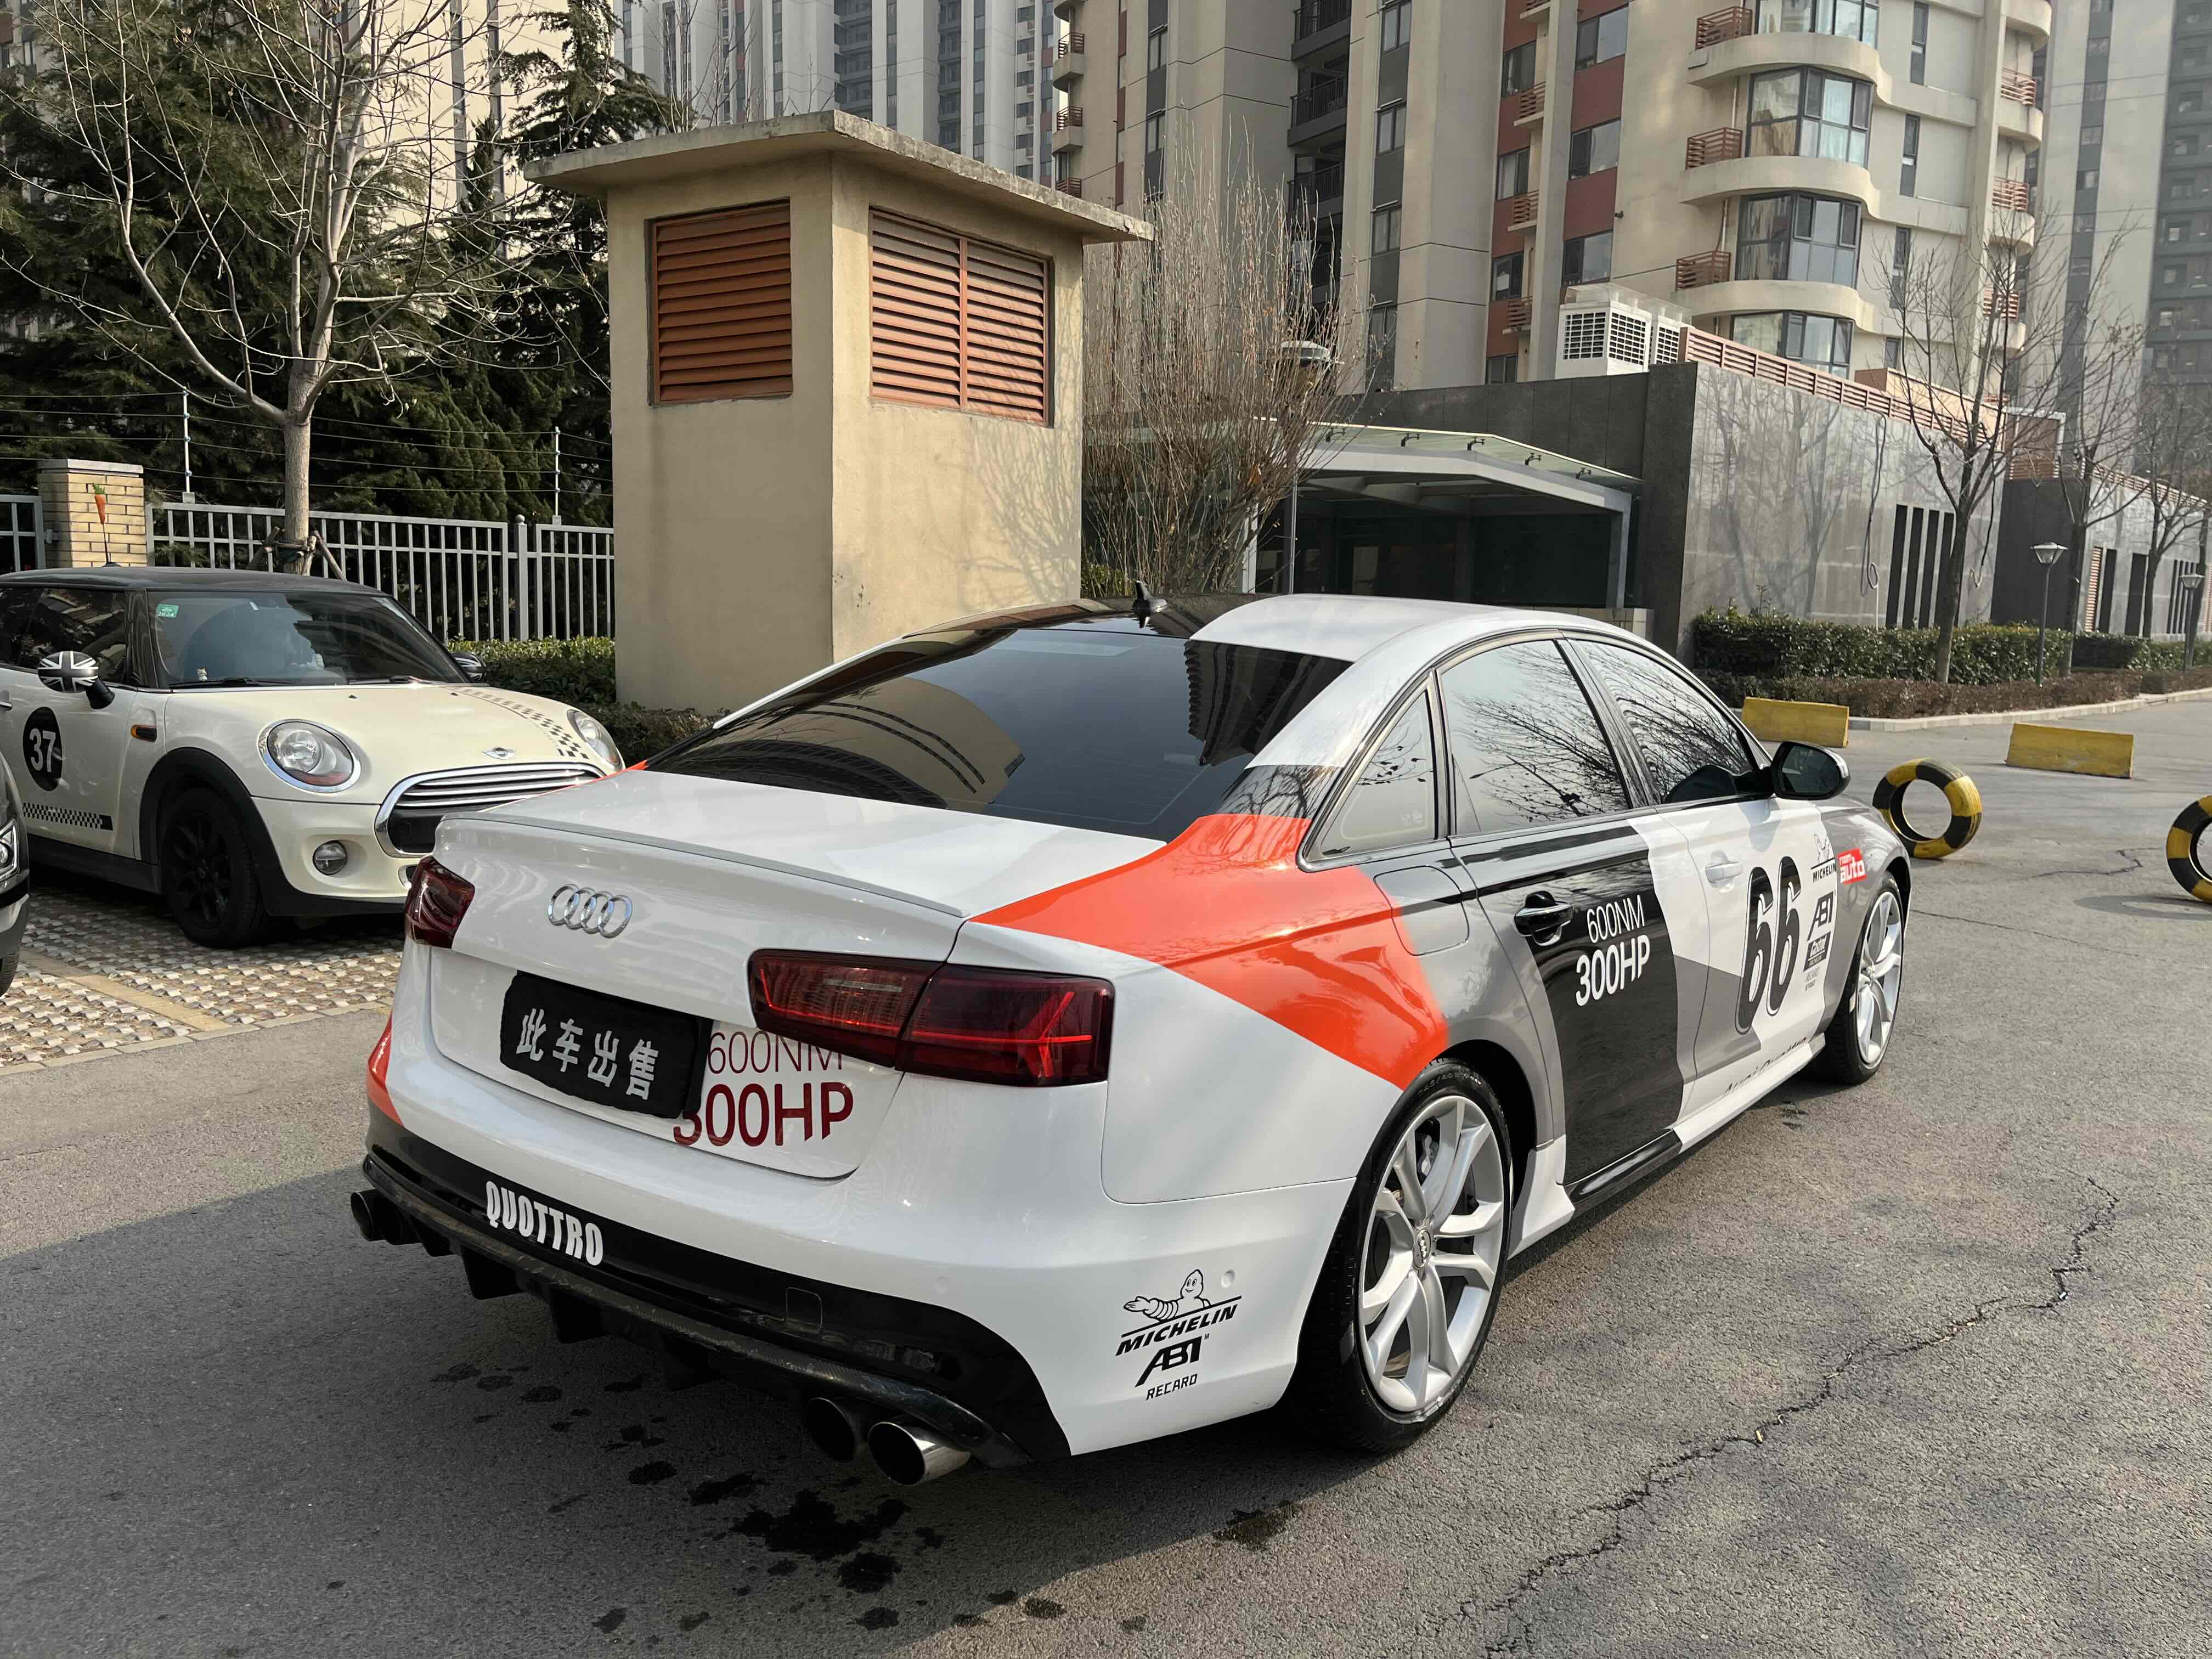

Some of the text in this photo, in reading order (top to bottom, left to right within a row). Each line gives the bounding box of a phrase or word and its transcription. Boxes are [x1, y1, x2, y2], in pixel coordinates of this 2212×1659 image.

[29, 728, 57, 772] 37
[1812, 863, 1837, 883] MICHELIN
[1839, 856, 1866, 883] auto
[1587, 894, 1645, 944] 600NM
[1735, 855, 1802, 1035] 66
[1576, 934, 1650, 1007] 300HP
[516, 1008, 659, 1101] 此车出售
[486, 1181, 603, 1266] QUOTTRO
[1115, 1304, 1238, 1356] MICHELIN
[1134, 1335, 1203, 1388] ABT
[1146, 1373, 1198, 1401] RECARO
